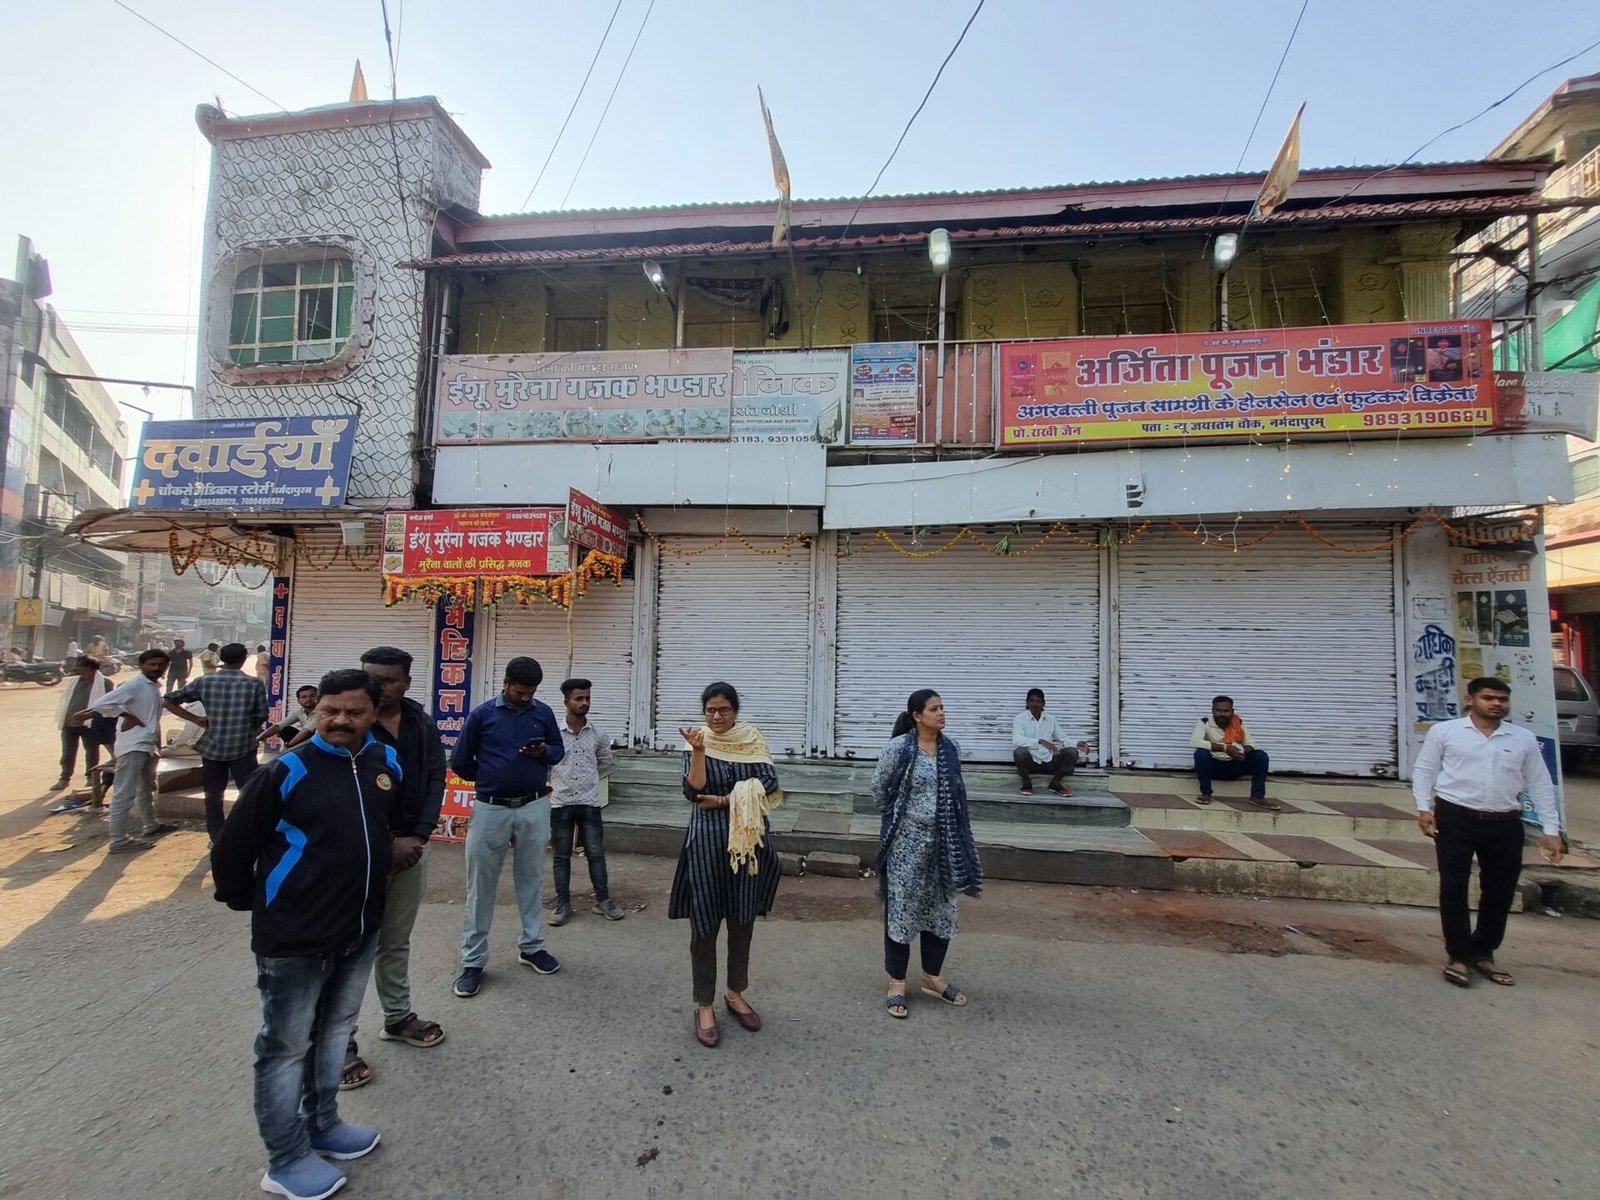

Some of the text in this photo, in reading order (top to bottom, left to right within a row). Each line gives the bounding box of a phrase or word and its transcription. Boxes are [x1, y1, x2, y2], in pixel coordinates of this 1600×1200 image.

[1075, 338, 1385, 391] अर्जिता पूजन भंडार
[448, 372, 728, 410] ईशू मुरैना गजक भण्डार
[1100, 400, 1148, 420] पूजन
[1150, 393, 1216, 415] सामग्री
[1218, 393, 1234, 412] के
[1236, 390, 1311, 412] होलसेल
[1312, 390, 1342, 407] एवं
[1344, 389, 1410, 411] फुटकर
[1411, 384, 1476, 405] विक्रेता
[1142, 423, 1162, 432] पता
[1173, 422, 1189, 434] न्यू
[1190, 418, 1234, 431] जयस्तंभ
[1269, 416, 1327, 430] नर्मदापुरम्
[1363, 410, 1488, 426] 9893190684
[1031, 426, 1058, 438] राखी
[1061, 426, 1082, 436] जैन
[143, 420, 348, 478] दवाईयाँ
[240, 481, 270, 495] स्टोर्स
[410, 526, 544, 554] ईशू मुरैना गजक भण्डार
[419, 556, 531, 572] मुरैना वालों की प्रसिद्ध गजक
